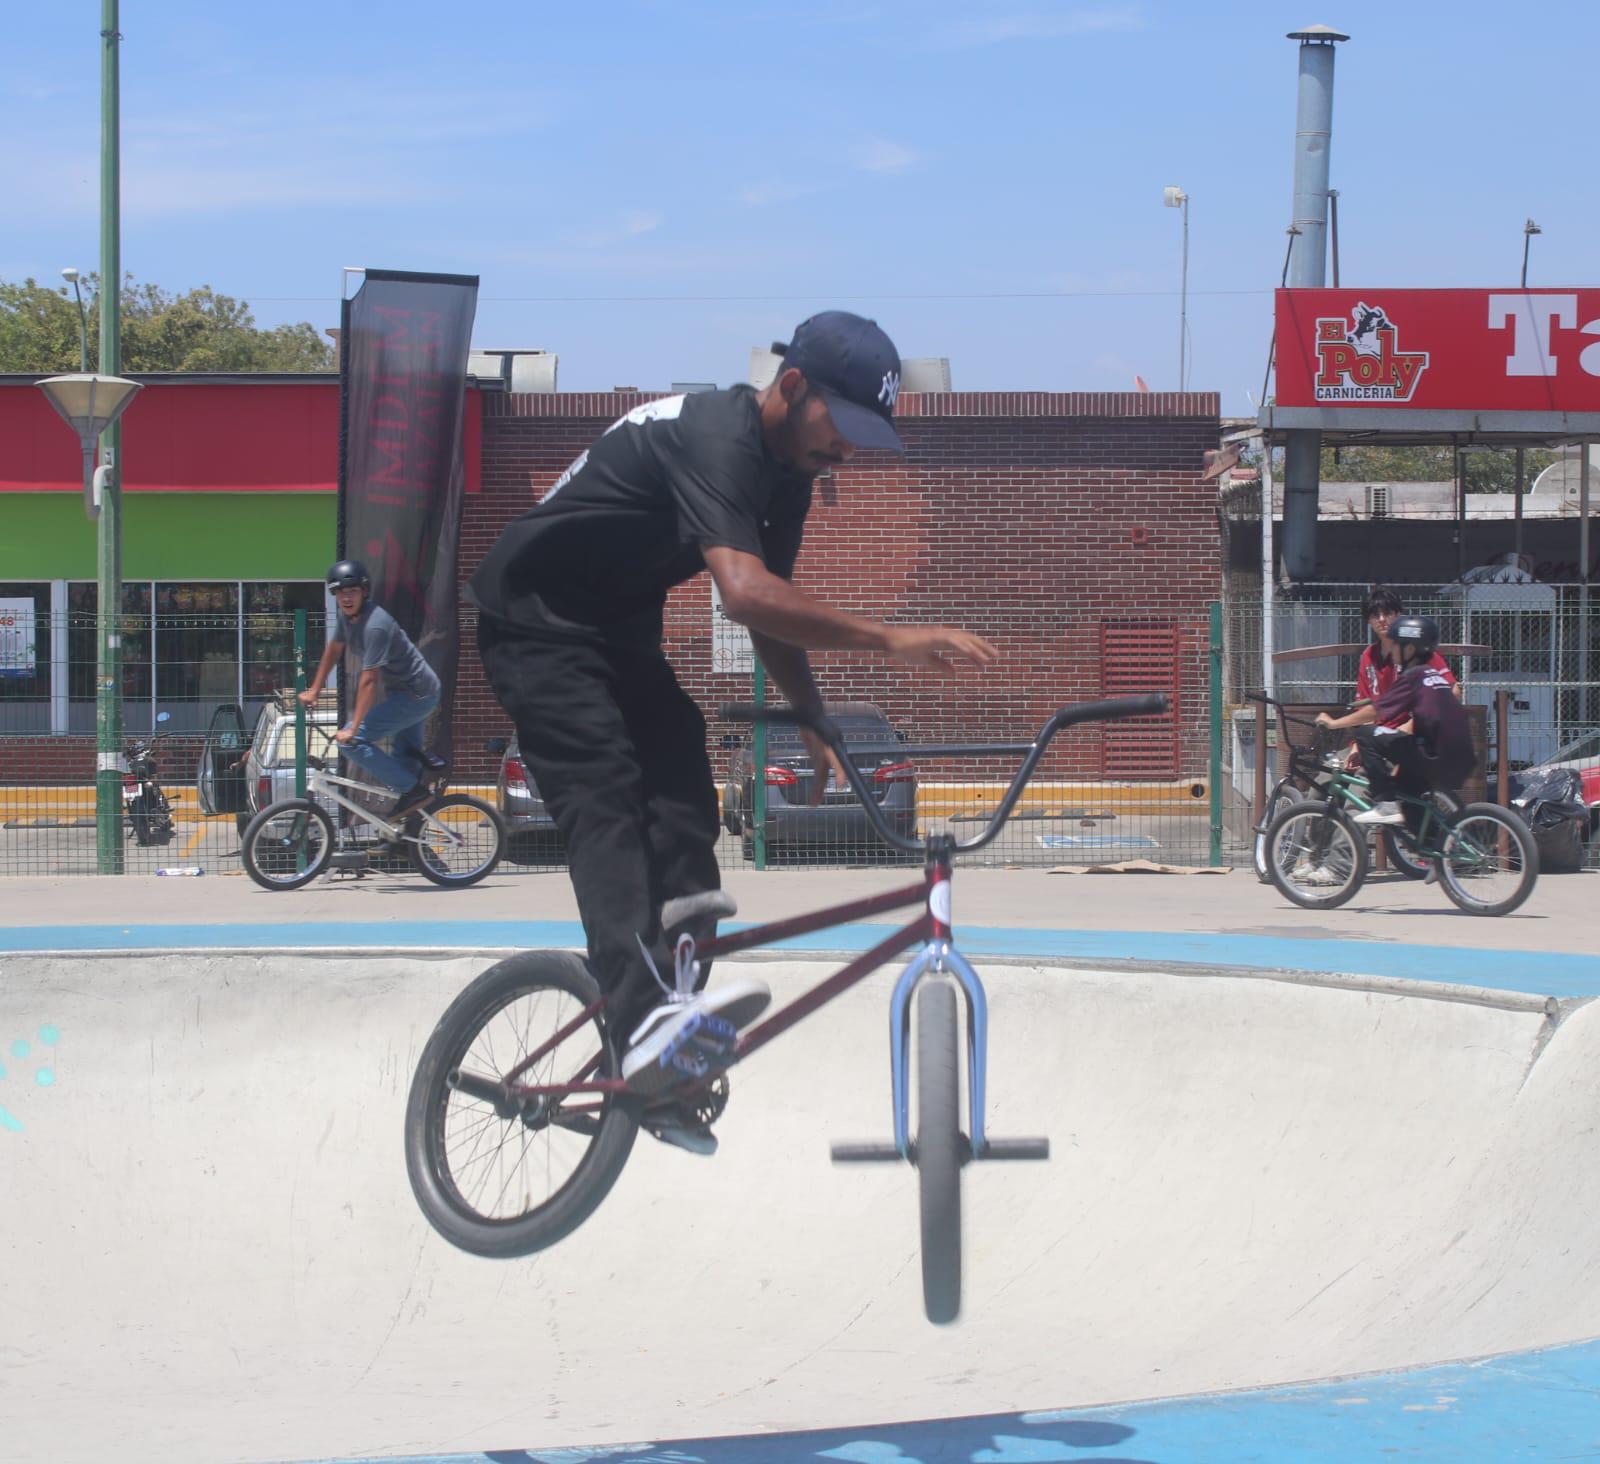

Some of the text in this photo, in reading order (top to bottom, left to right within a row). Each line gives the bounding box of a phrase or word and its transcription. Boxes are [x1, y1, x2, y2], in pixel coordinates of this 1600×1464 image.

[1318, 328, 1426, 398] Poly
[877, 370, 900, 407] NY
[1316, 387, 1393, 399] CARNICERIA
